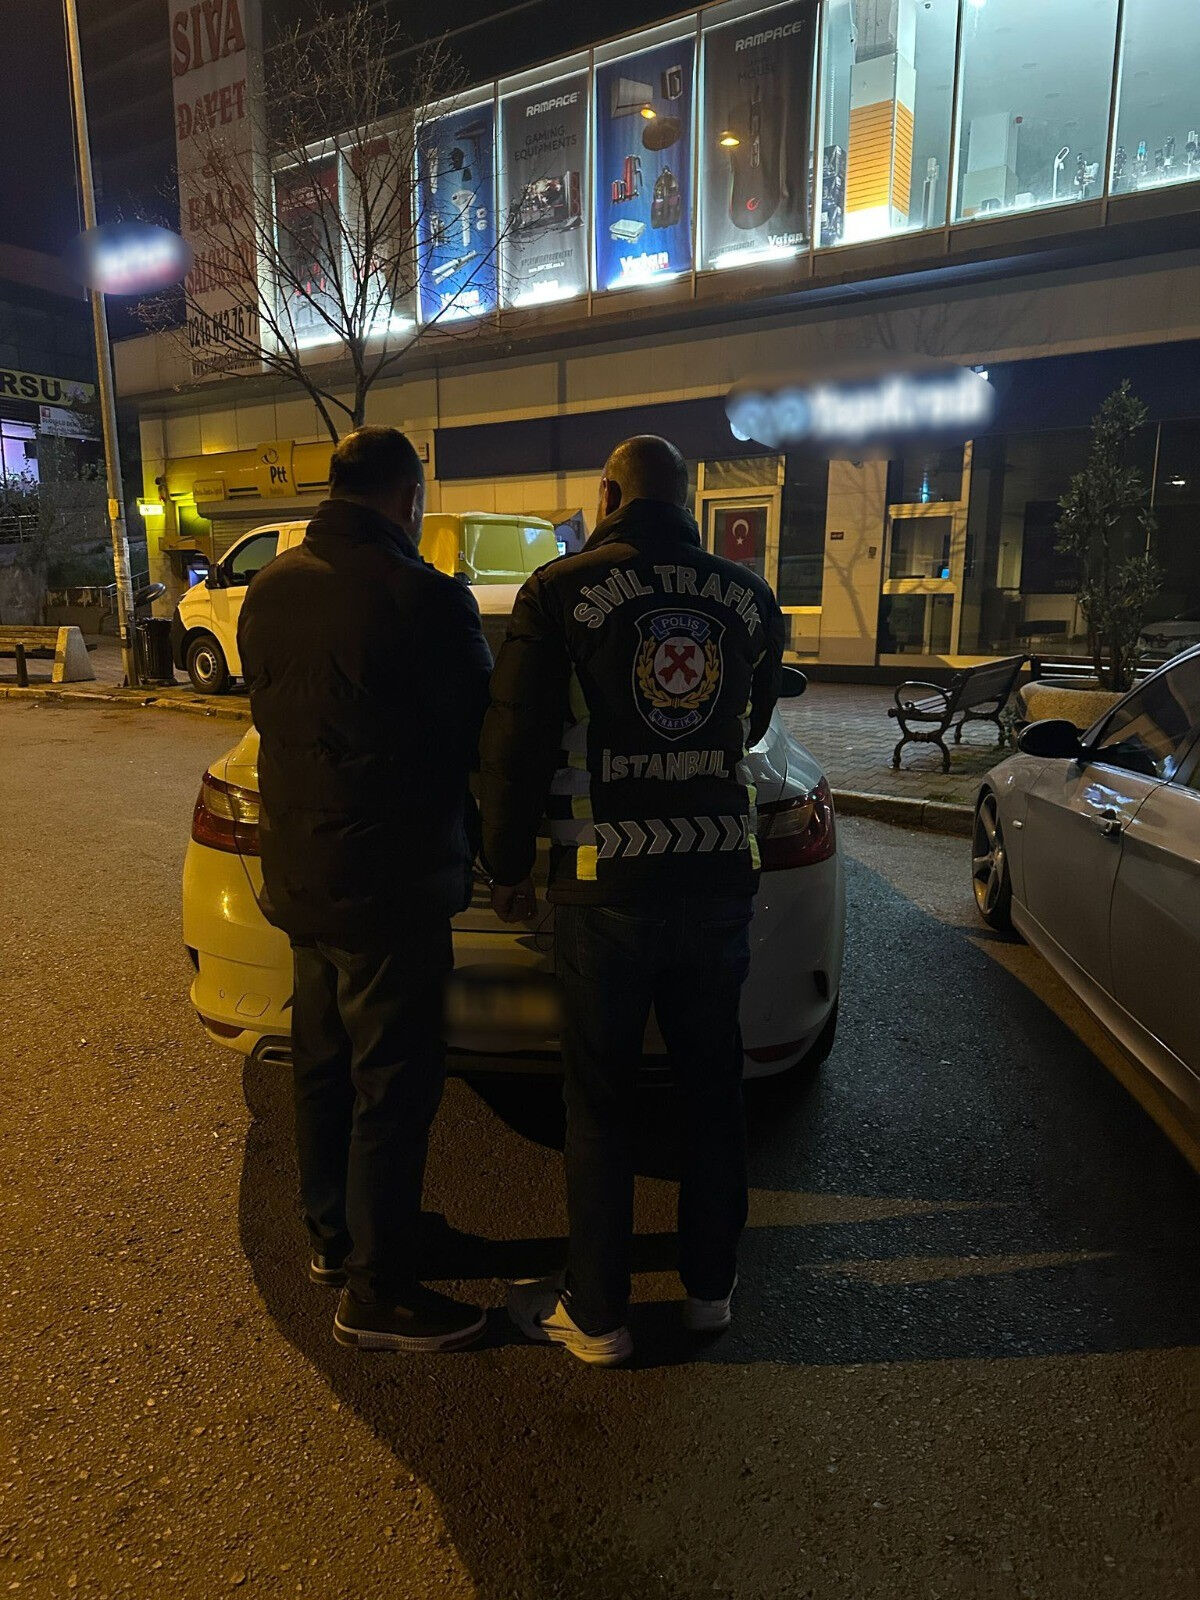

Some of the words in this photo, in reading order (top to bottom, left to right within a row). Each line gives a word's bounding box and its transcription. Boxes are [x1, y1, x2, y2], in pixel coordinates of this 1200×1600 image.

[736, 20, 802, 51] RAMPAGE
[177, 80, 246, 140] DAVET
[526, 92, 578, 117] RAMPAGE
[514, 135, 577, 160] EQUIPMENTS
[525, 125, 565, 146] GAMING
[768, 232, 803, 250] Vatan
[270, 466, 288, 484] Ptt
[573, 567, 654, 629] SİVİL
[654, 564, 762, 637] TRAFİK
[661, 616, 700, 632] POLİS
[602, 749, 729, 783] İSTANBUL
